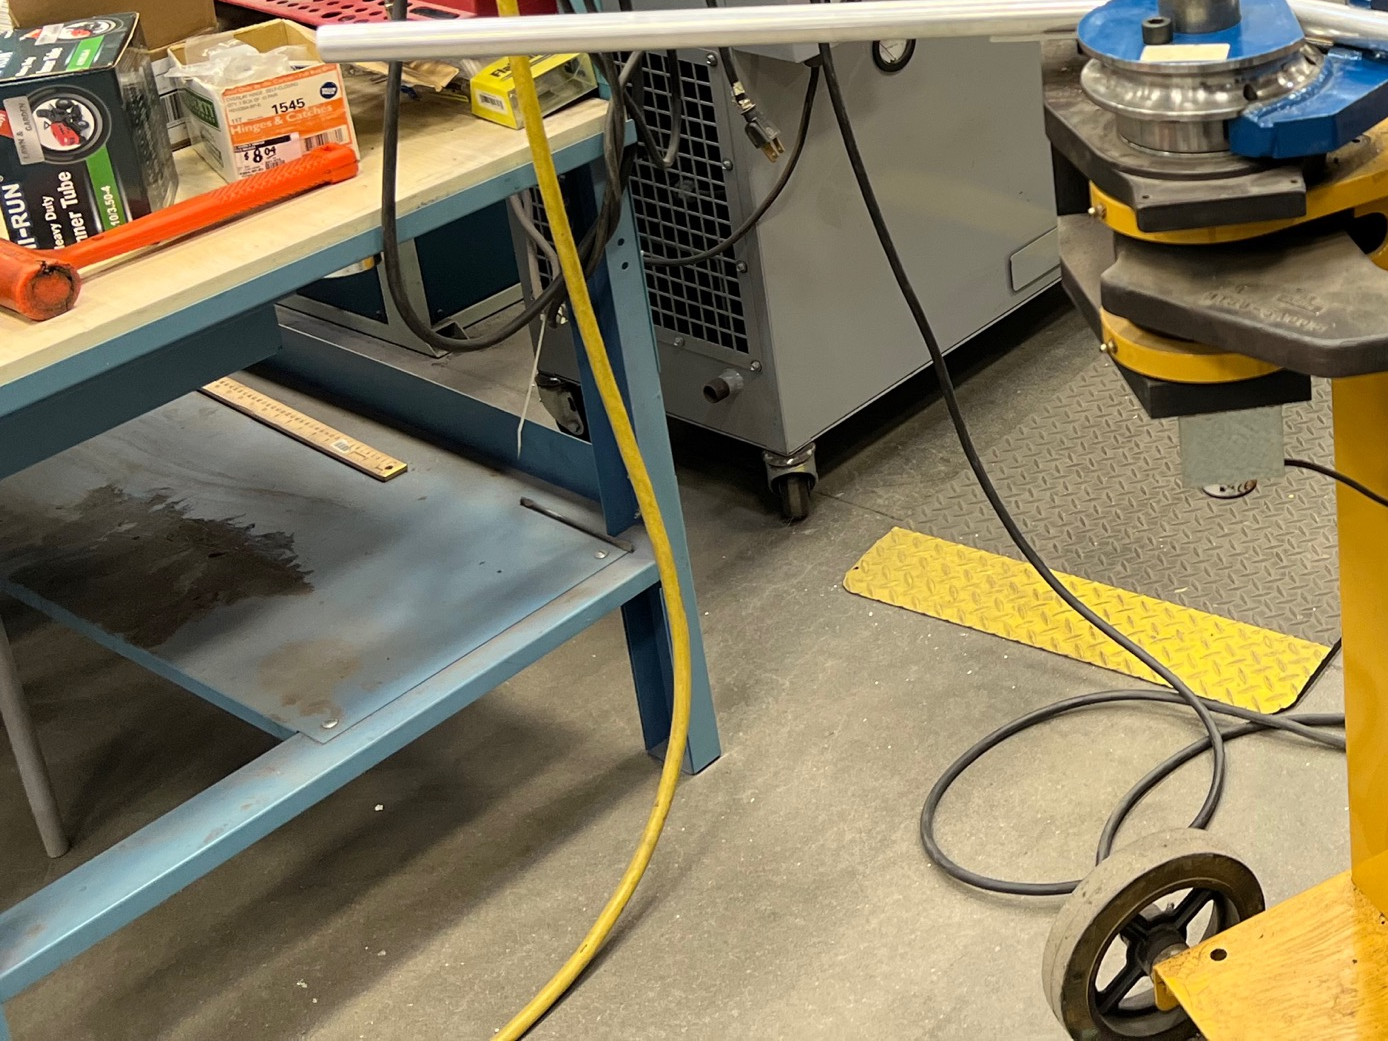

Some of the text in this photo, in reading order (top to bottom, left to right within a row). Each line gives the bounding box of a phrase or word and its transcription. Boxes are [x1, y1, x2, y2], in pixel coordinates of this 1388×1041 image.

[490, 63, 511, 78] Fla
[271, 97, 306, 115] 1545
[230, 104, 333, 137] Hinges & Catches
[41, 195, 56, 222] Duty
[57, 171, 88, 243] nner Tube
